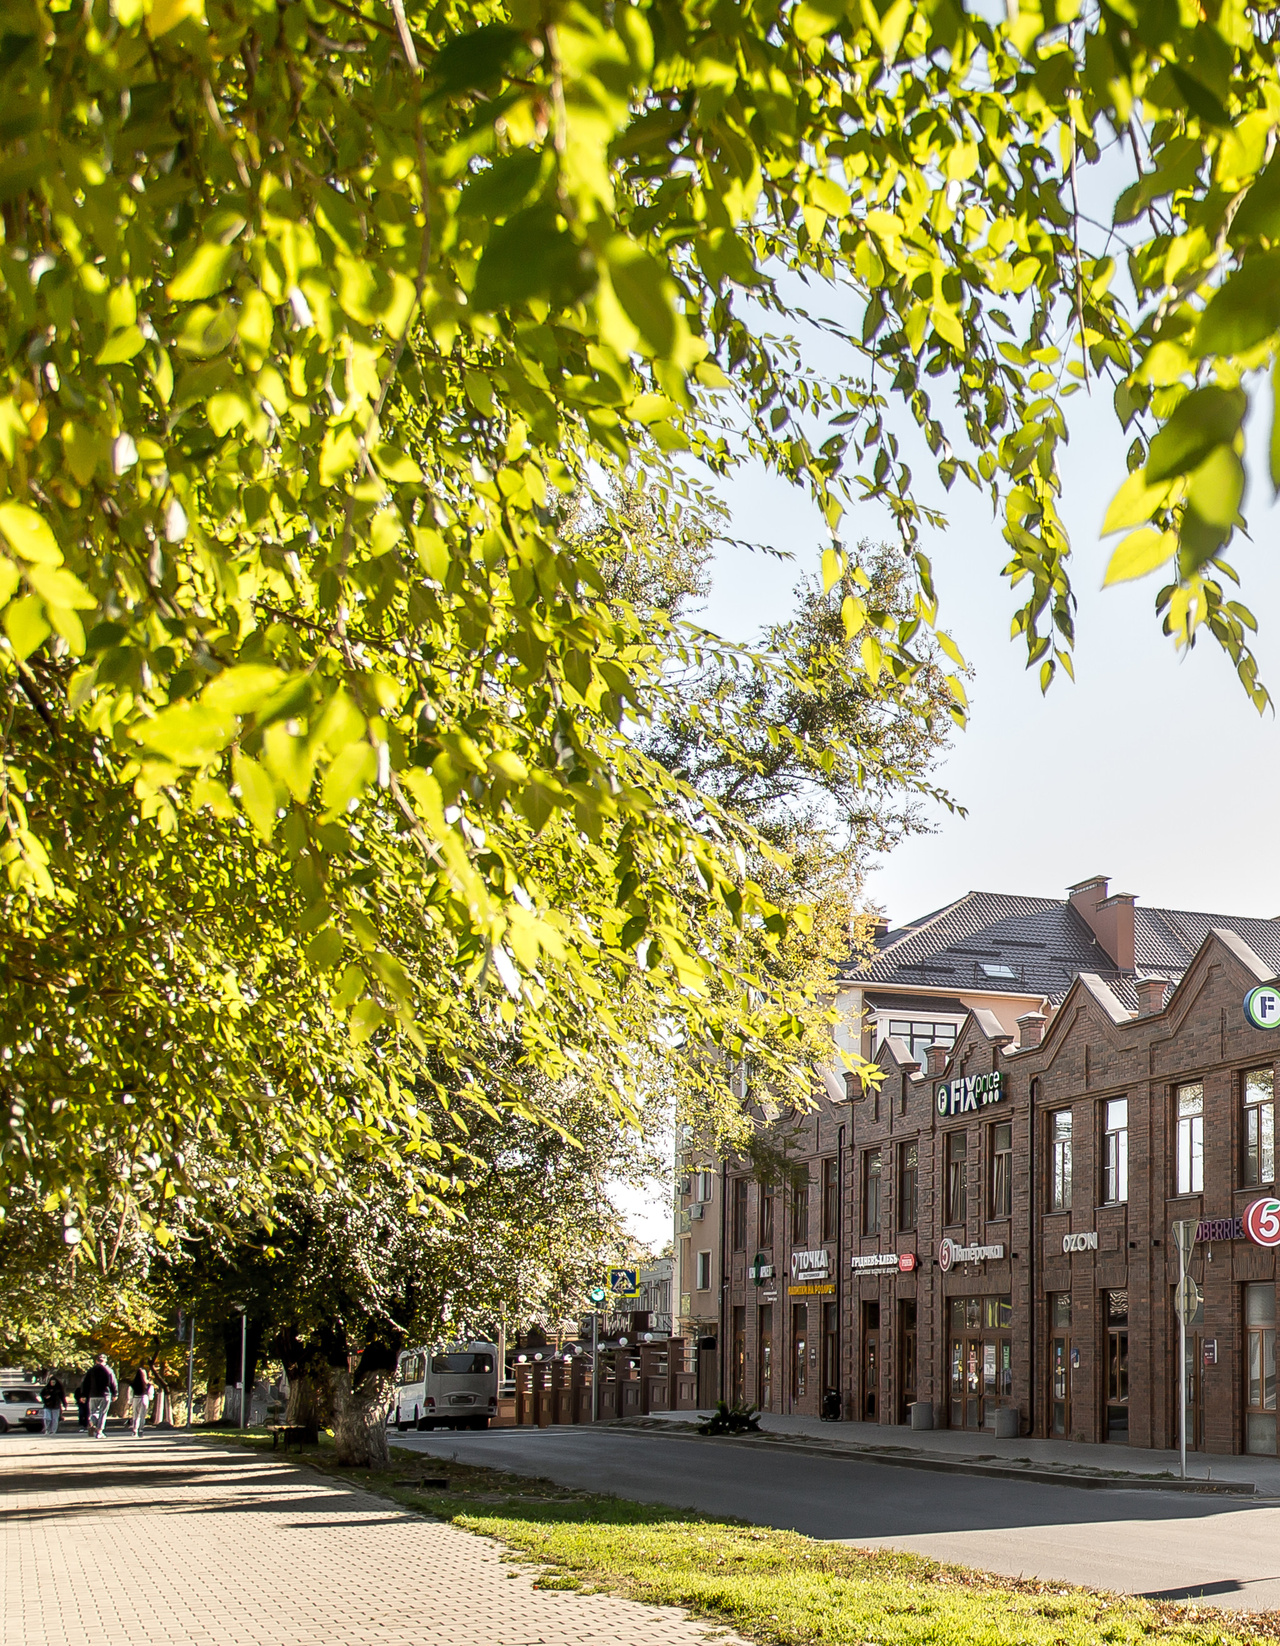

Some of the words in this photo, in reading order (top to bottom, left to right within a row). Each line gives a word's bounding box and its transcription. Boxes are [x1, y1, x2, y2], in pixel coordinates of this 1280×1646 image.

[1260, 996, 1275, 1019] F
[1196, 1218, 1246, 1241] DBERRIES
[952, 1242, 1004, 1266] Пятёрочка
[1062, 1232, 1098, 1253] OZON
[799, 1250, 829, 1270] ТОЧКА
